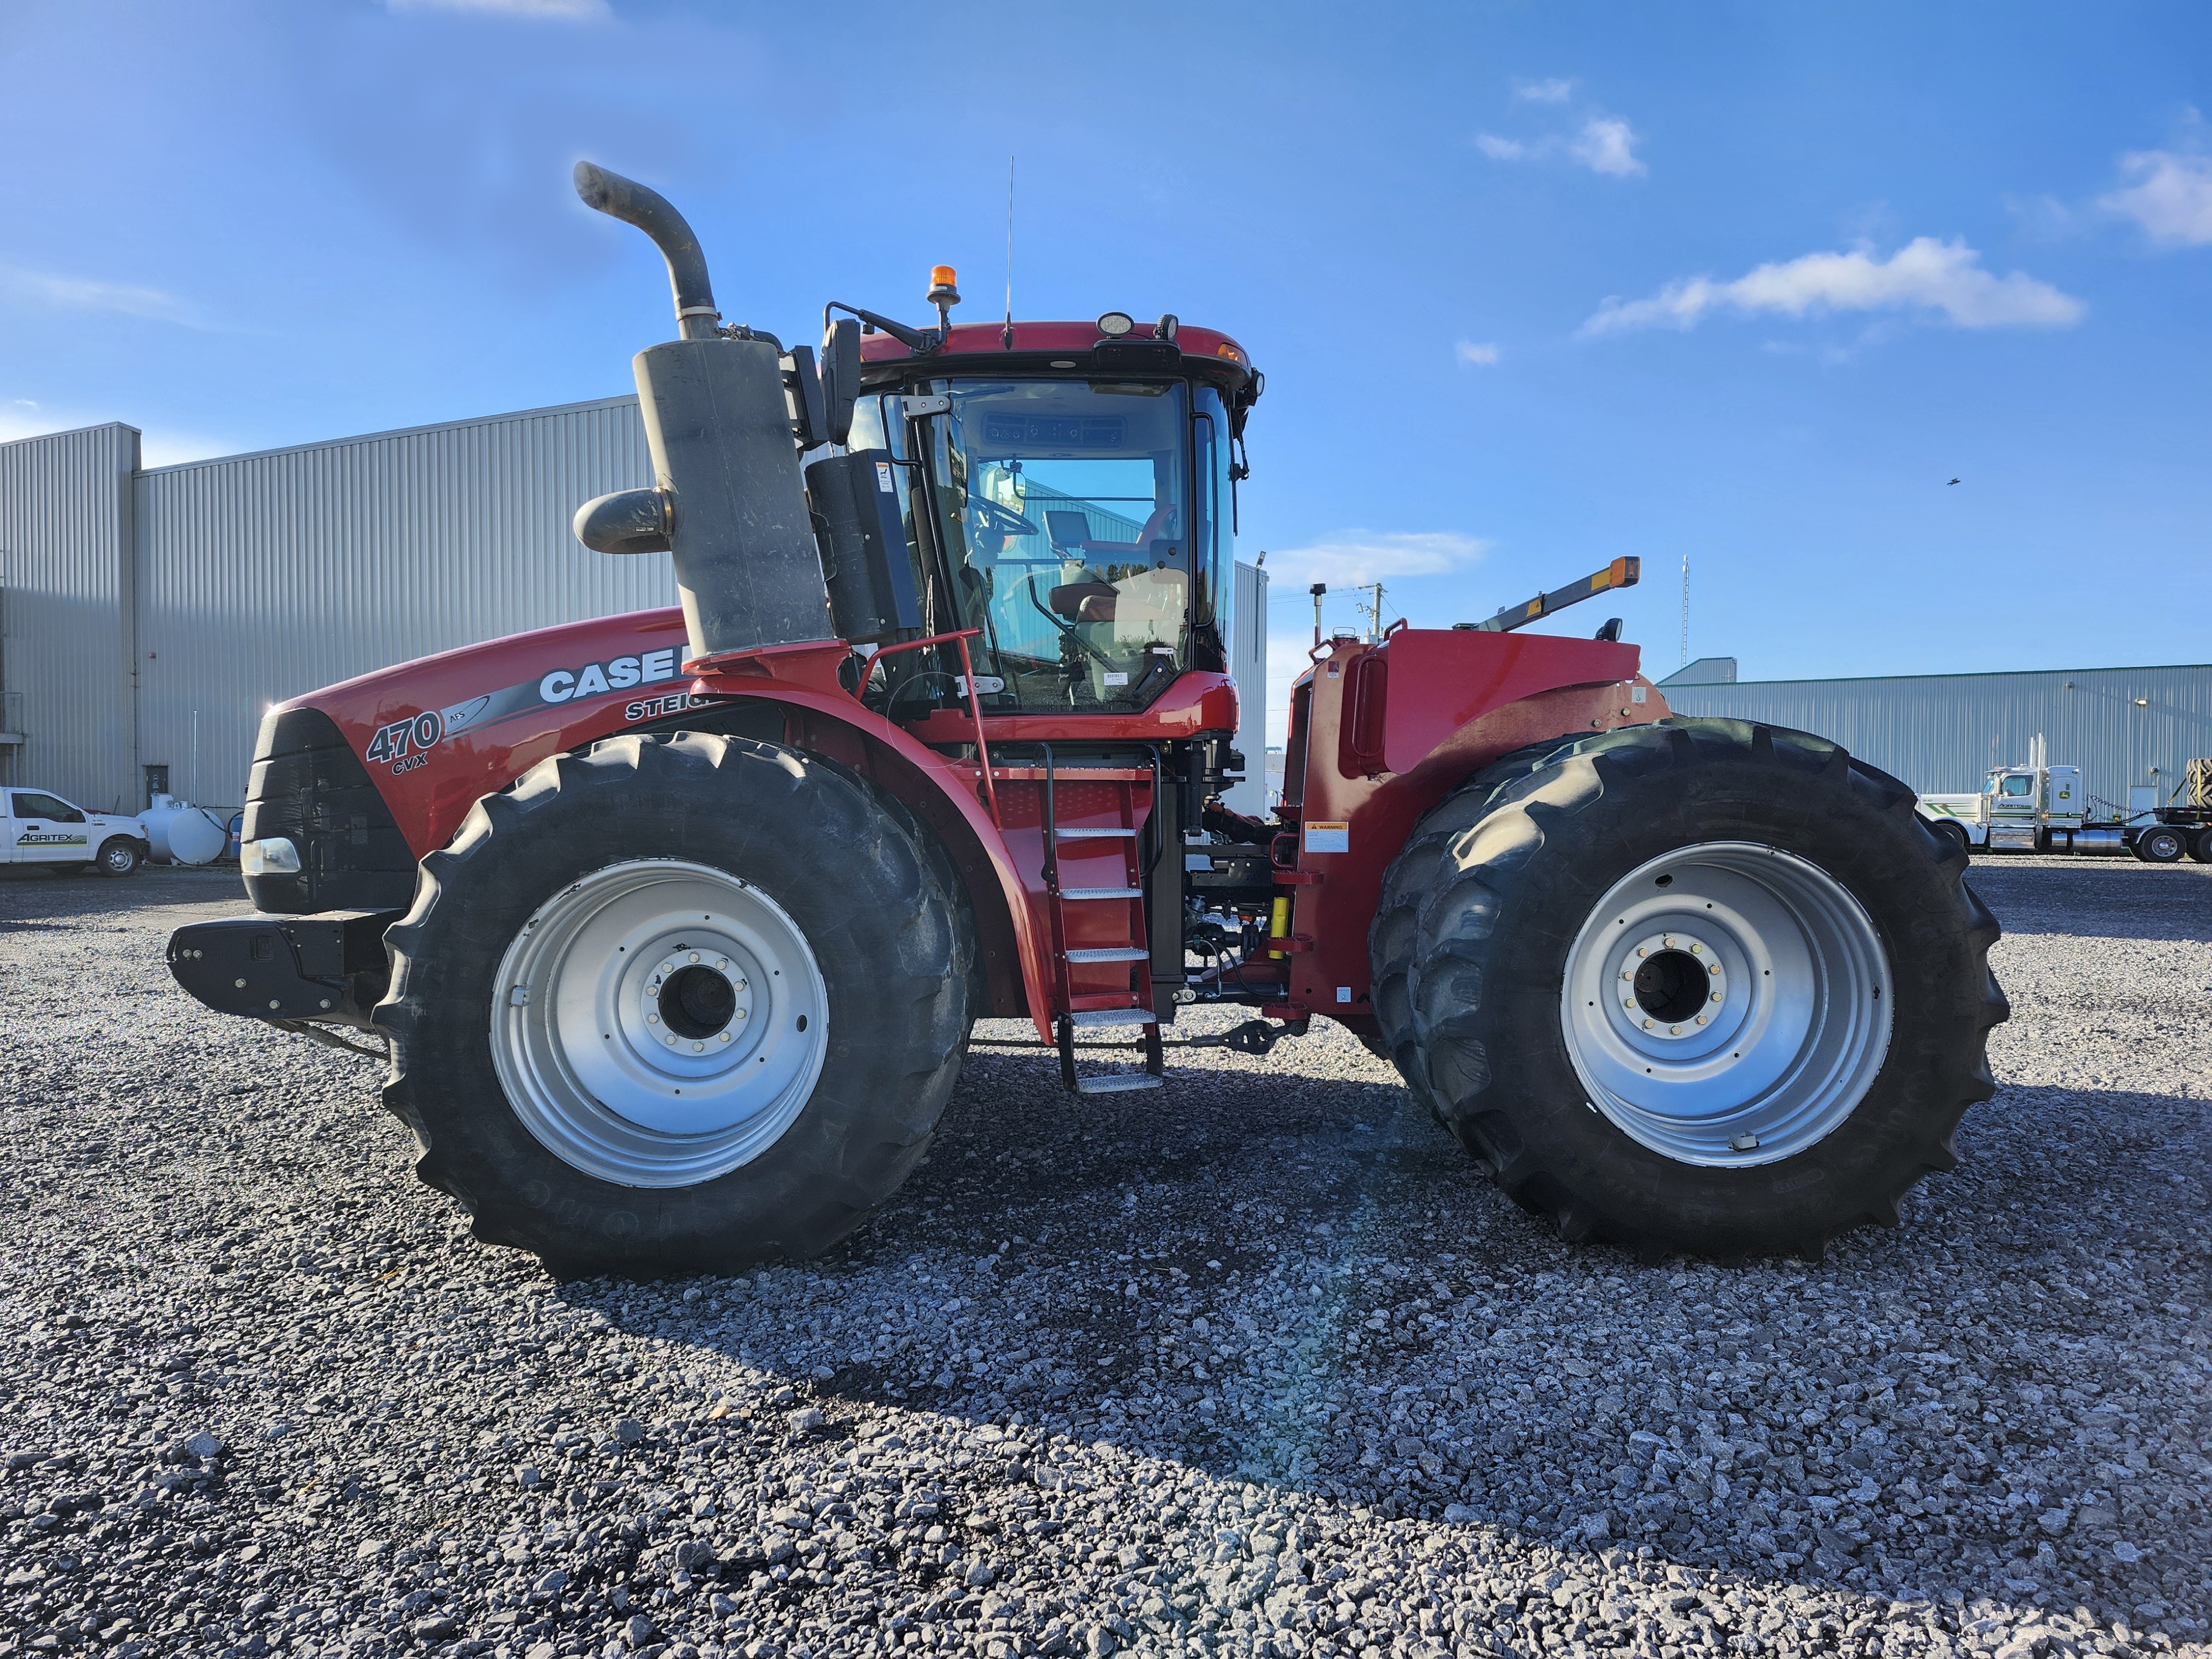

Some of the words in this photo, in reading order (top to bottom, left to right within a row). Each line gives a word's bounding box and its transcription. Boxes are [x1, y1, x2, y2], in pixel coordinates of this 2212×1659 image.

[540, 649, 673, 702] CASE
[450, 711, 465, 723] AFS
[625, 692, 726, 721] STEIG
[366, 711, 441, 764] 470
[392, 751, 428, 775] CVX
[17, 833, 73, 842] AGRITEX
